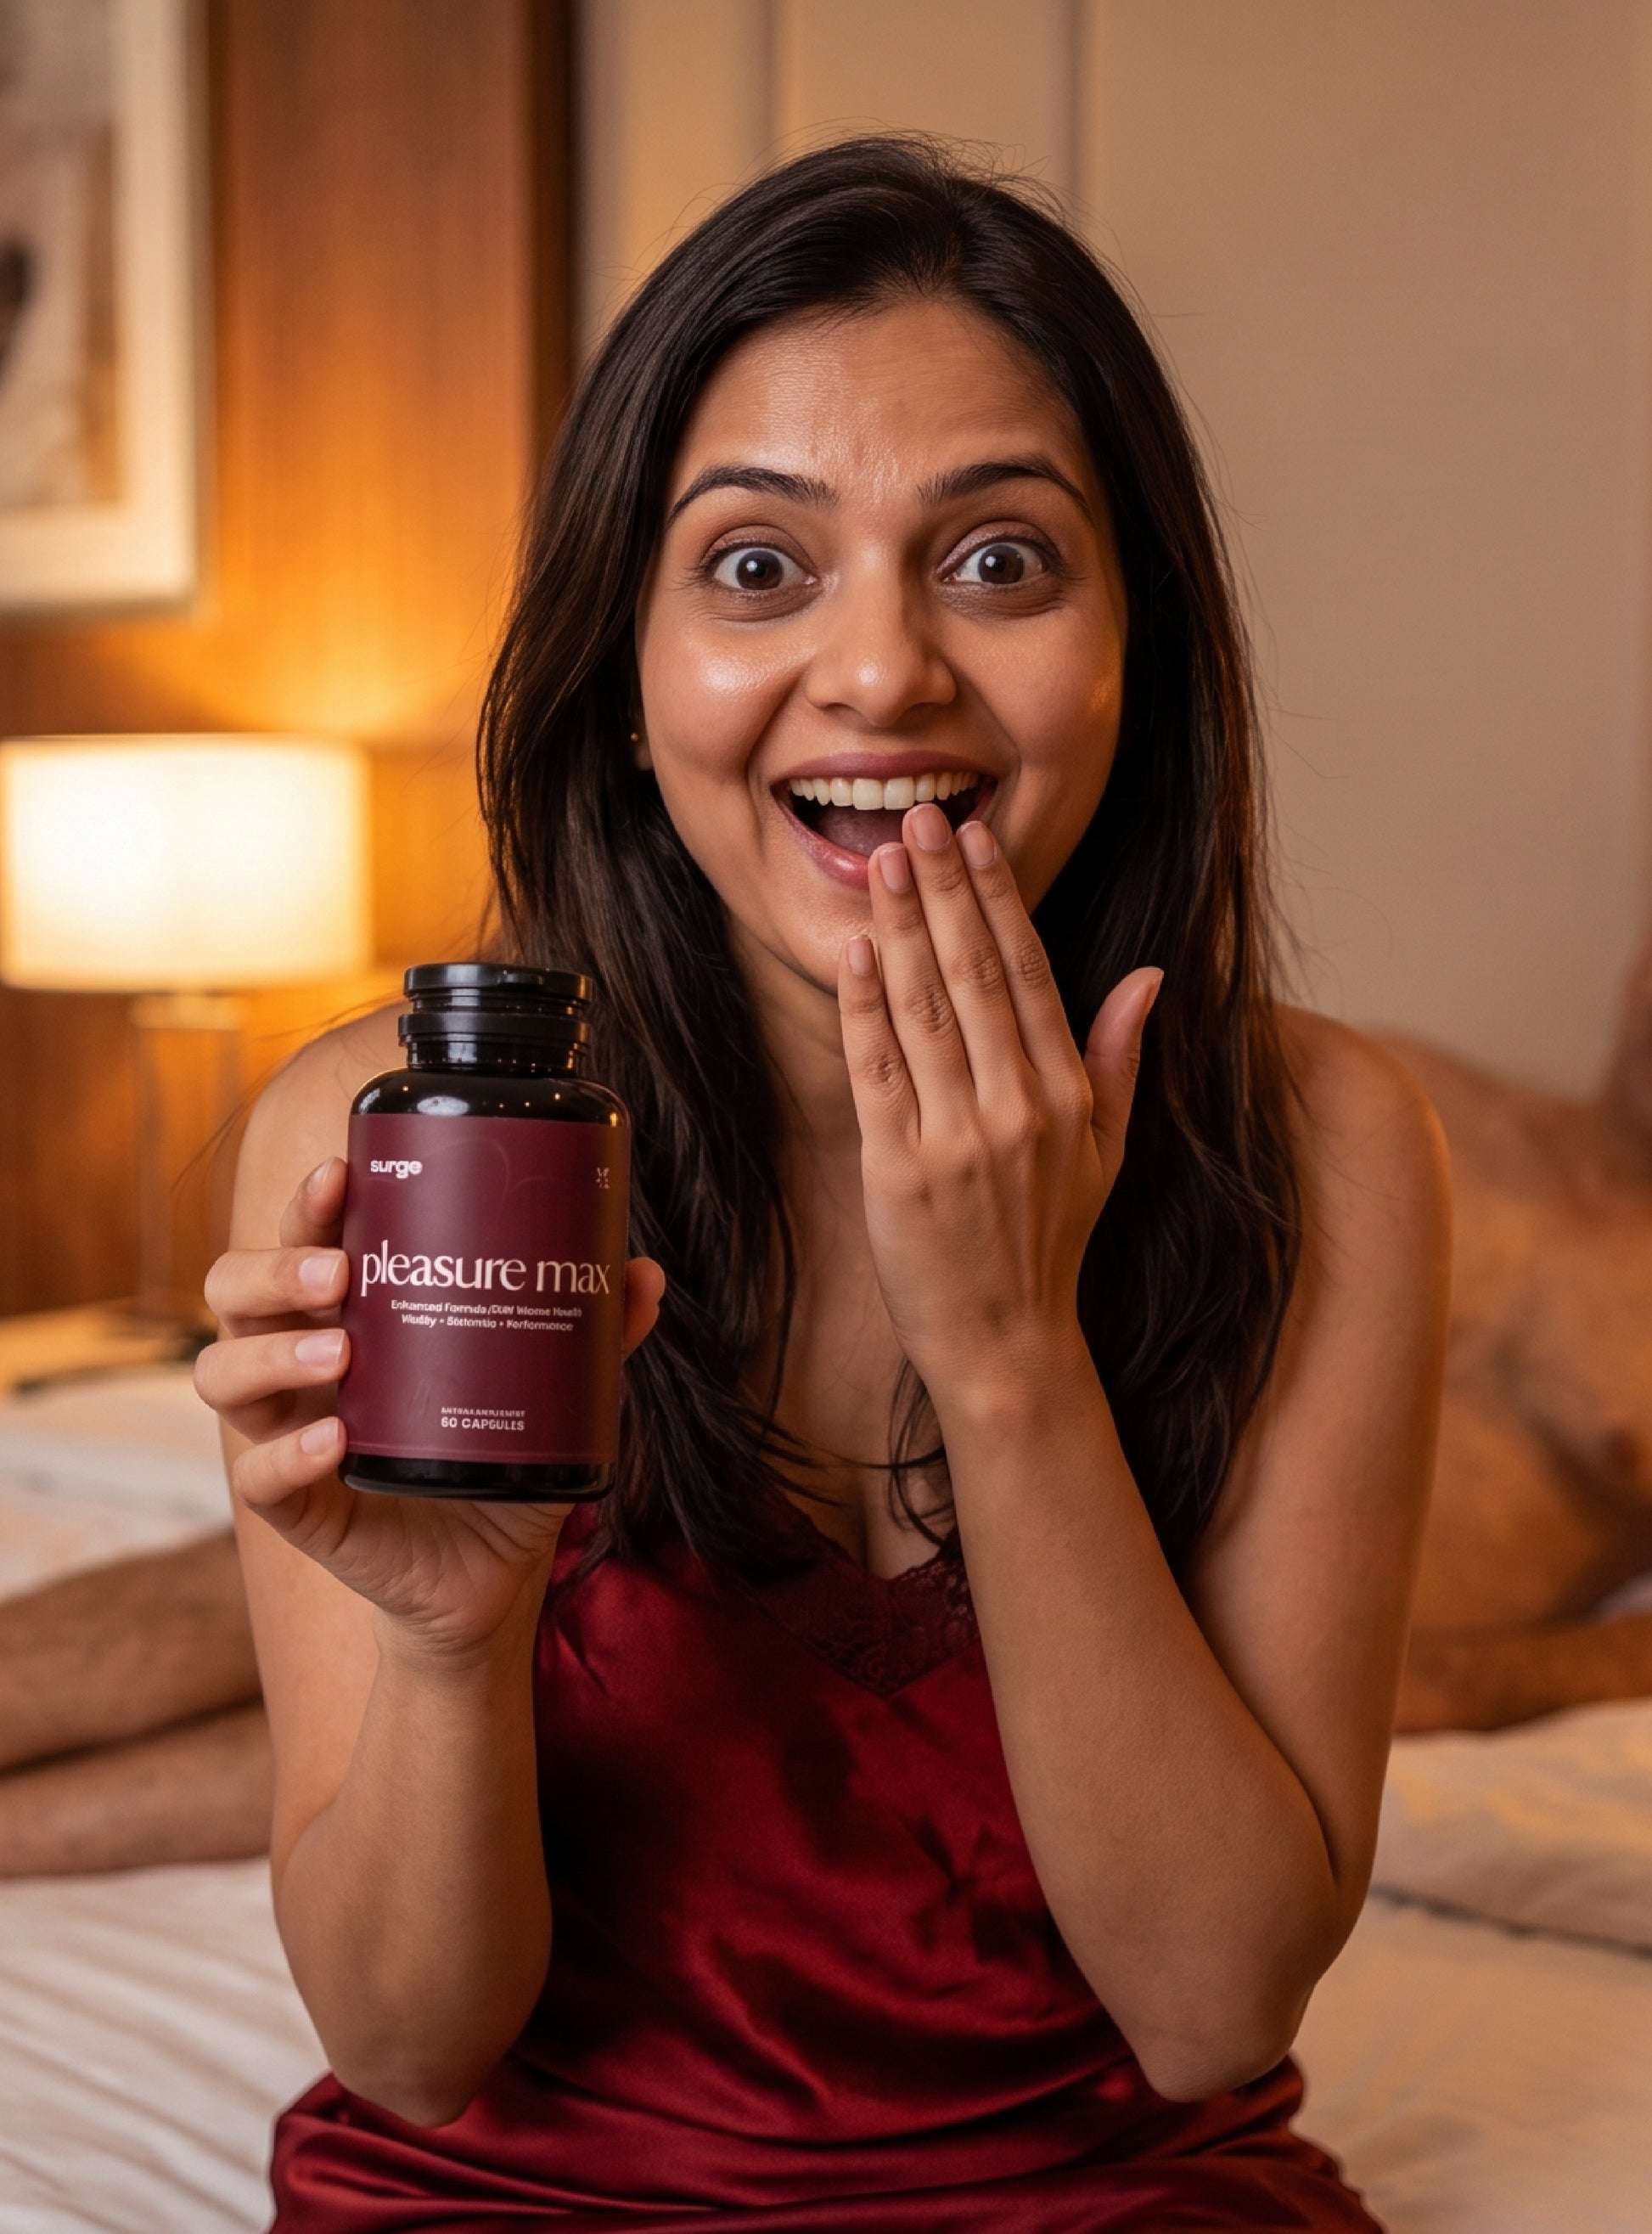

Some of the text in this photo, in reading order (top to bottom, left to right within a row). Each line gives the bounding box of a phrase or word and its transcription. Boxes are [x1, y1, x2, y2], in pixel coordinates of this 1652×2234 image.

[371, 1159, 423, 1179] surge
[361, 1240, 610, 1297] pleasure max
[441, 1416, 458, 1427] 60
